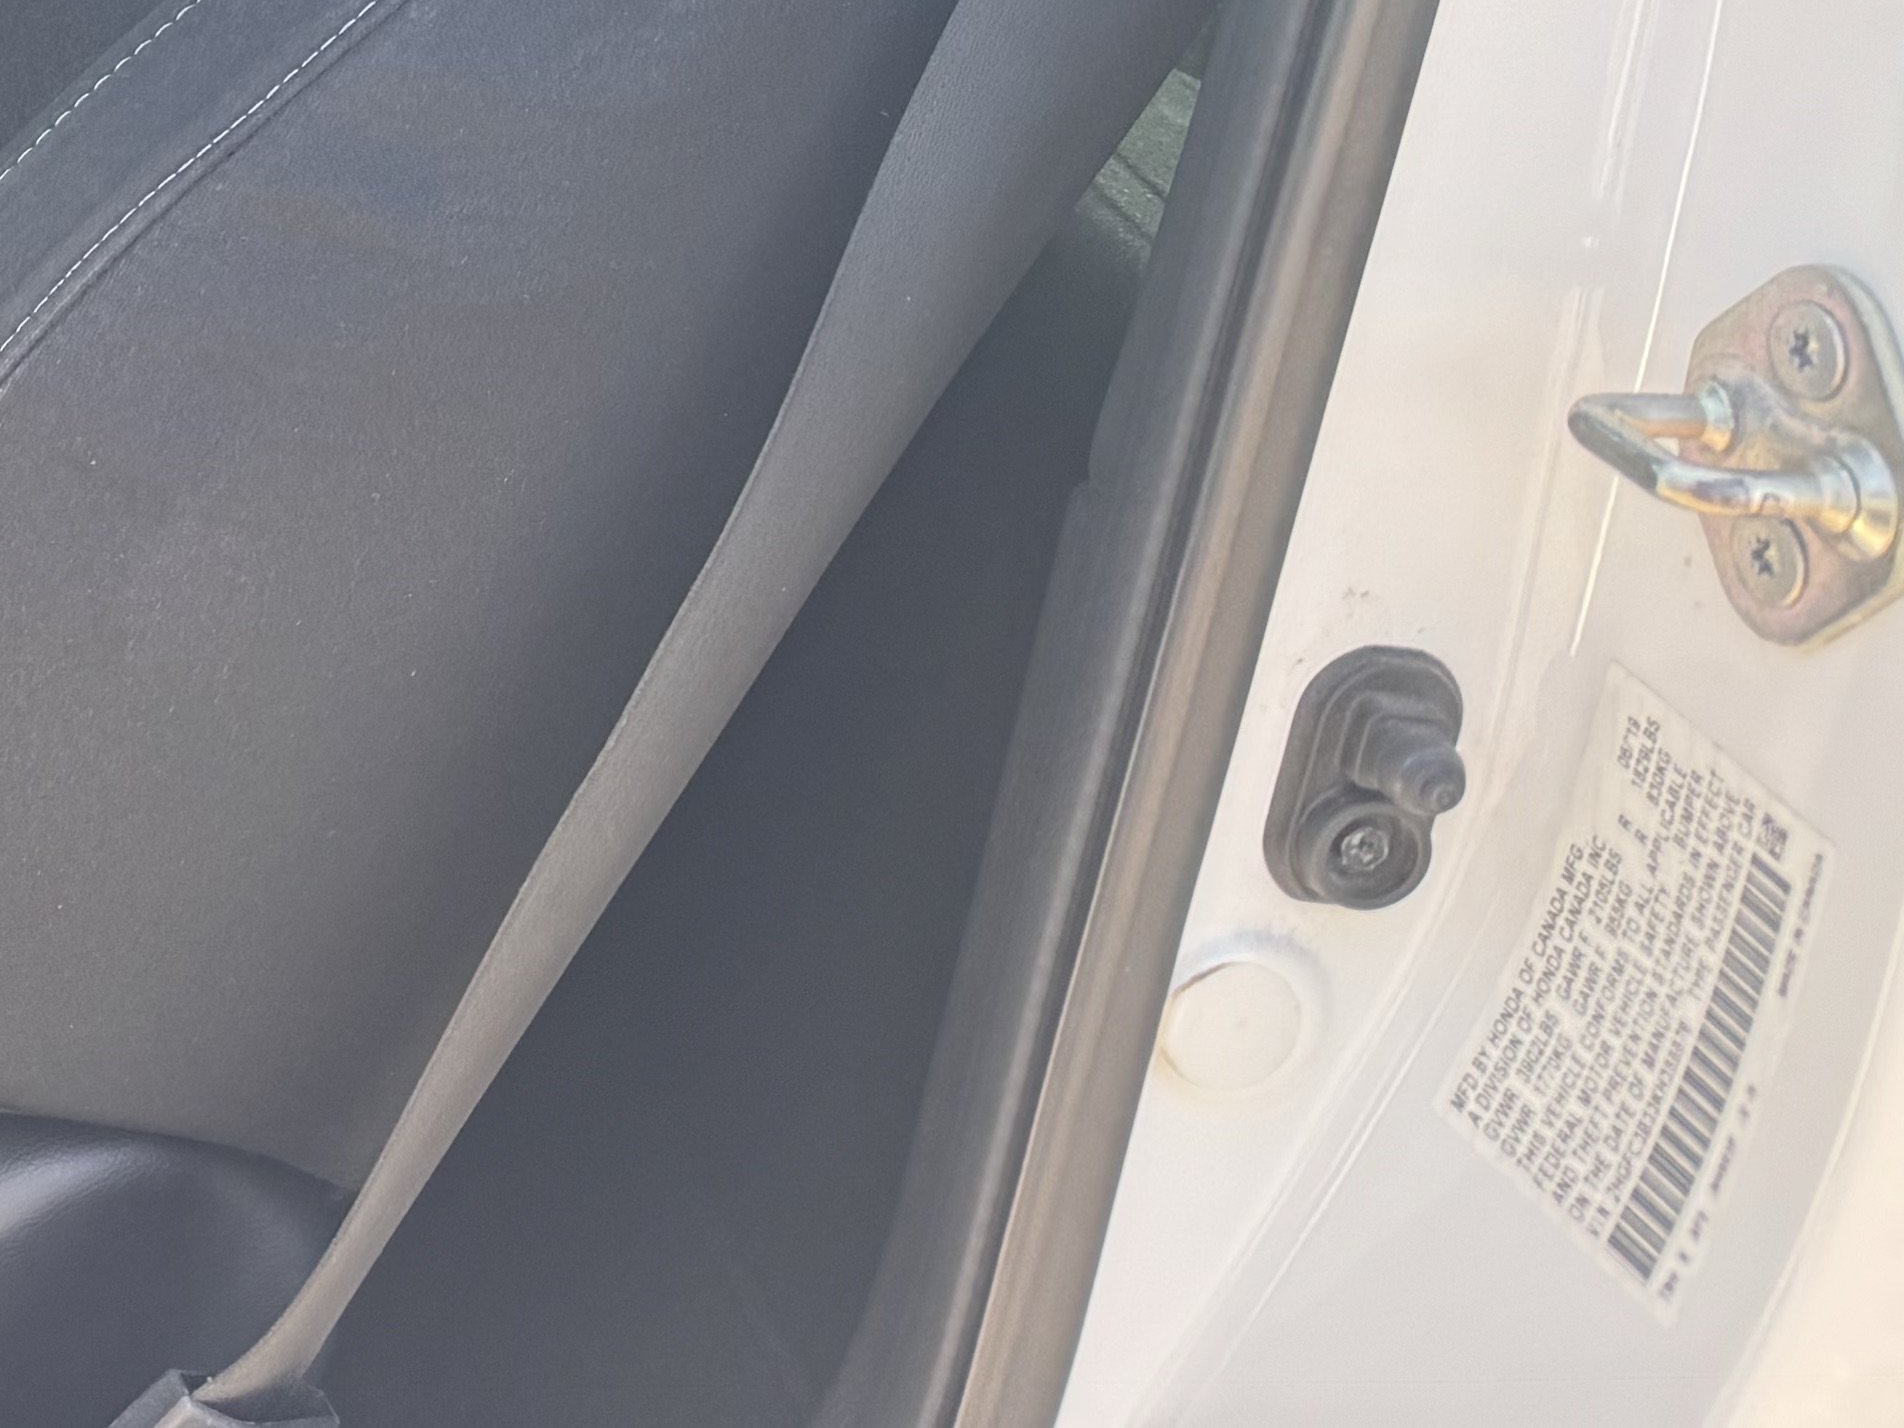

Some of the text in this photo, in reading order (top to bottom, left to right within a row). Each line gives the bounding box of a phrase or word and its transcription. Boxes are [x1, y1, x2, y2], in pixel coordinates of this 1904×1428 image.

[1473, 1033, 1523, 1112] DIVISION
[1515, 1004, 1535, 1036] OF
[1530, 940, 1565, 1006] HONDA
[1557, 866, 1595, 944] CANADA
[1515, 762, 1687, 1174] THIS VEHICLE CONFORMS TO ALL APPLICABLE
[1531, 767, 1704, 1191] FEDERAL MOTOR VEHICLE SAFETY BUMPER
[1550, 1161, 1579, 1206] AND
[1570, 1101, 1608, 1163] THEFT
[1600, 983, 1660, 1106] PREVENTION
[1648, 869, 1696, 986] STANDARDS
[1692, 767, 1725, 846] EFFECT
[1702, 839, 1746, 953] PASSENGER
[1736, 796, 1757, 839] CAR
[1450, 1069, 1479, 1113] MFD
[1471, 1045, 1491, 1075] BY
[1486, 983, 1525, 1048] HONDA
[1517, 956, 1537, 987] OF
[1530, 883, 1568, 959] CANADA
[1481, 1086, 1517, 1145] GVWR
[1554, 944, 1586, 1003] GAWR
[1498, 1102, 1534, 1161] GVWR
[1571, 959, 1602, 1018] GAWR
[1567, 788, 1740, 1225] ON THE DATE OF MANUFACTURE SHOWN ABOVE
